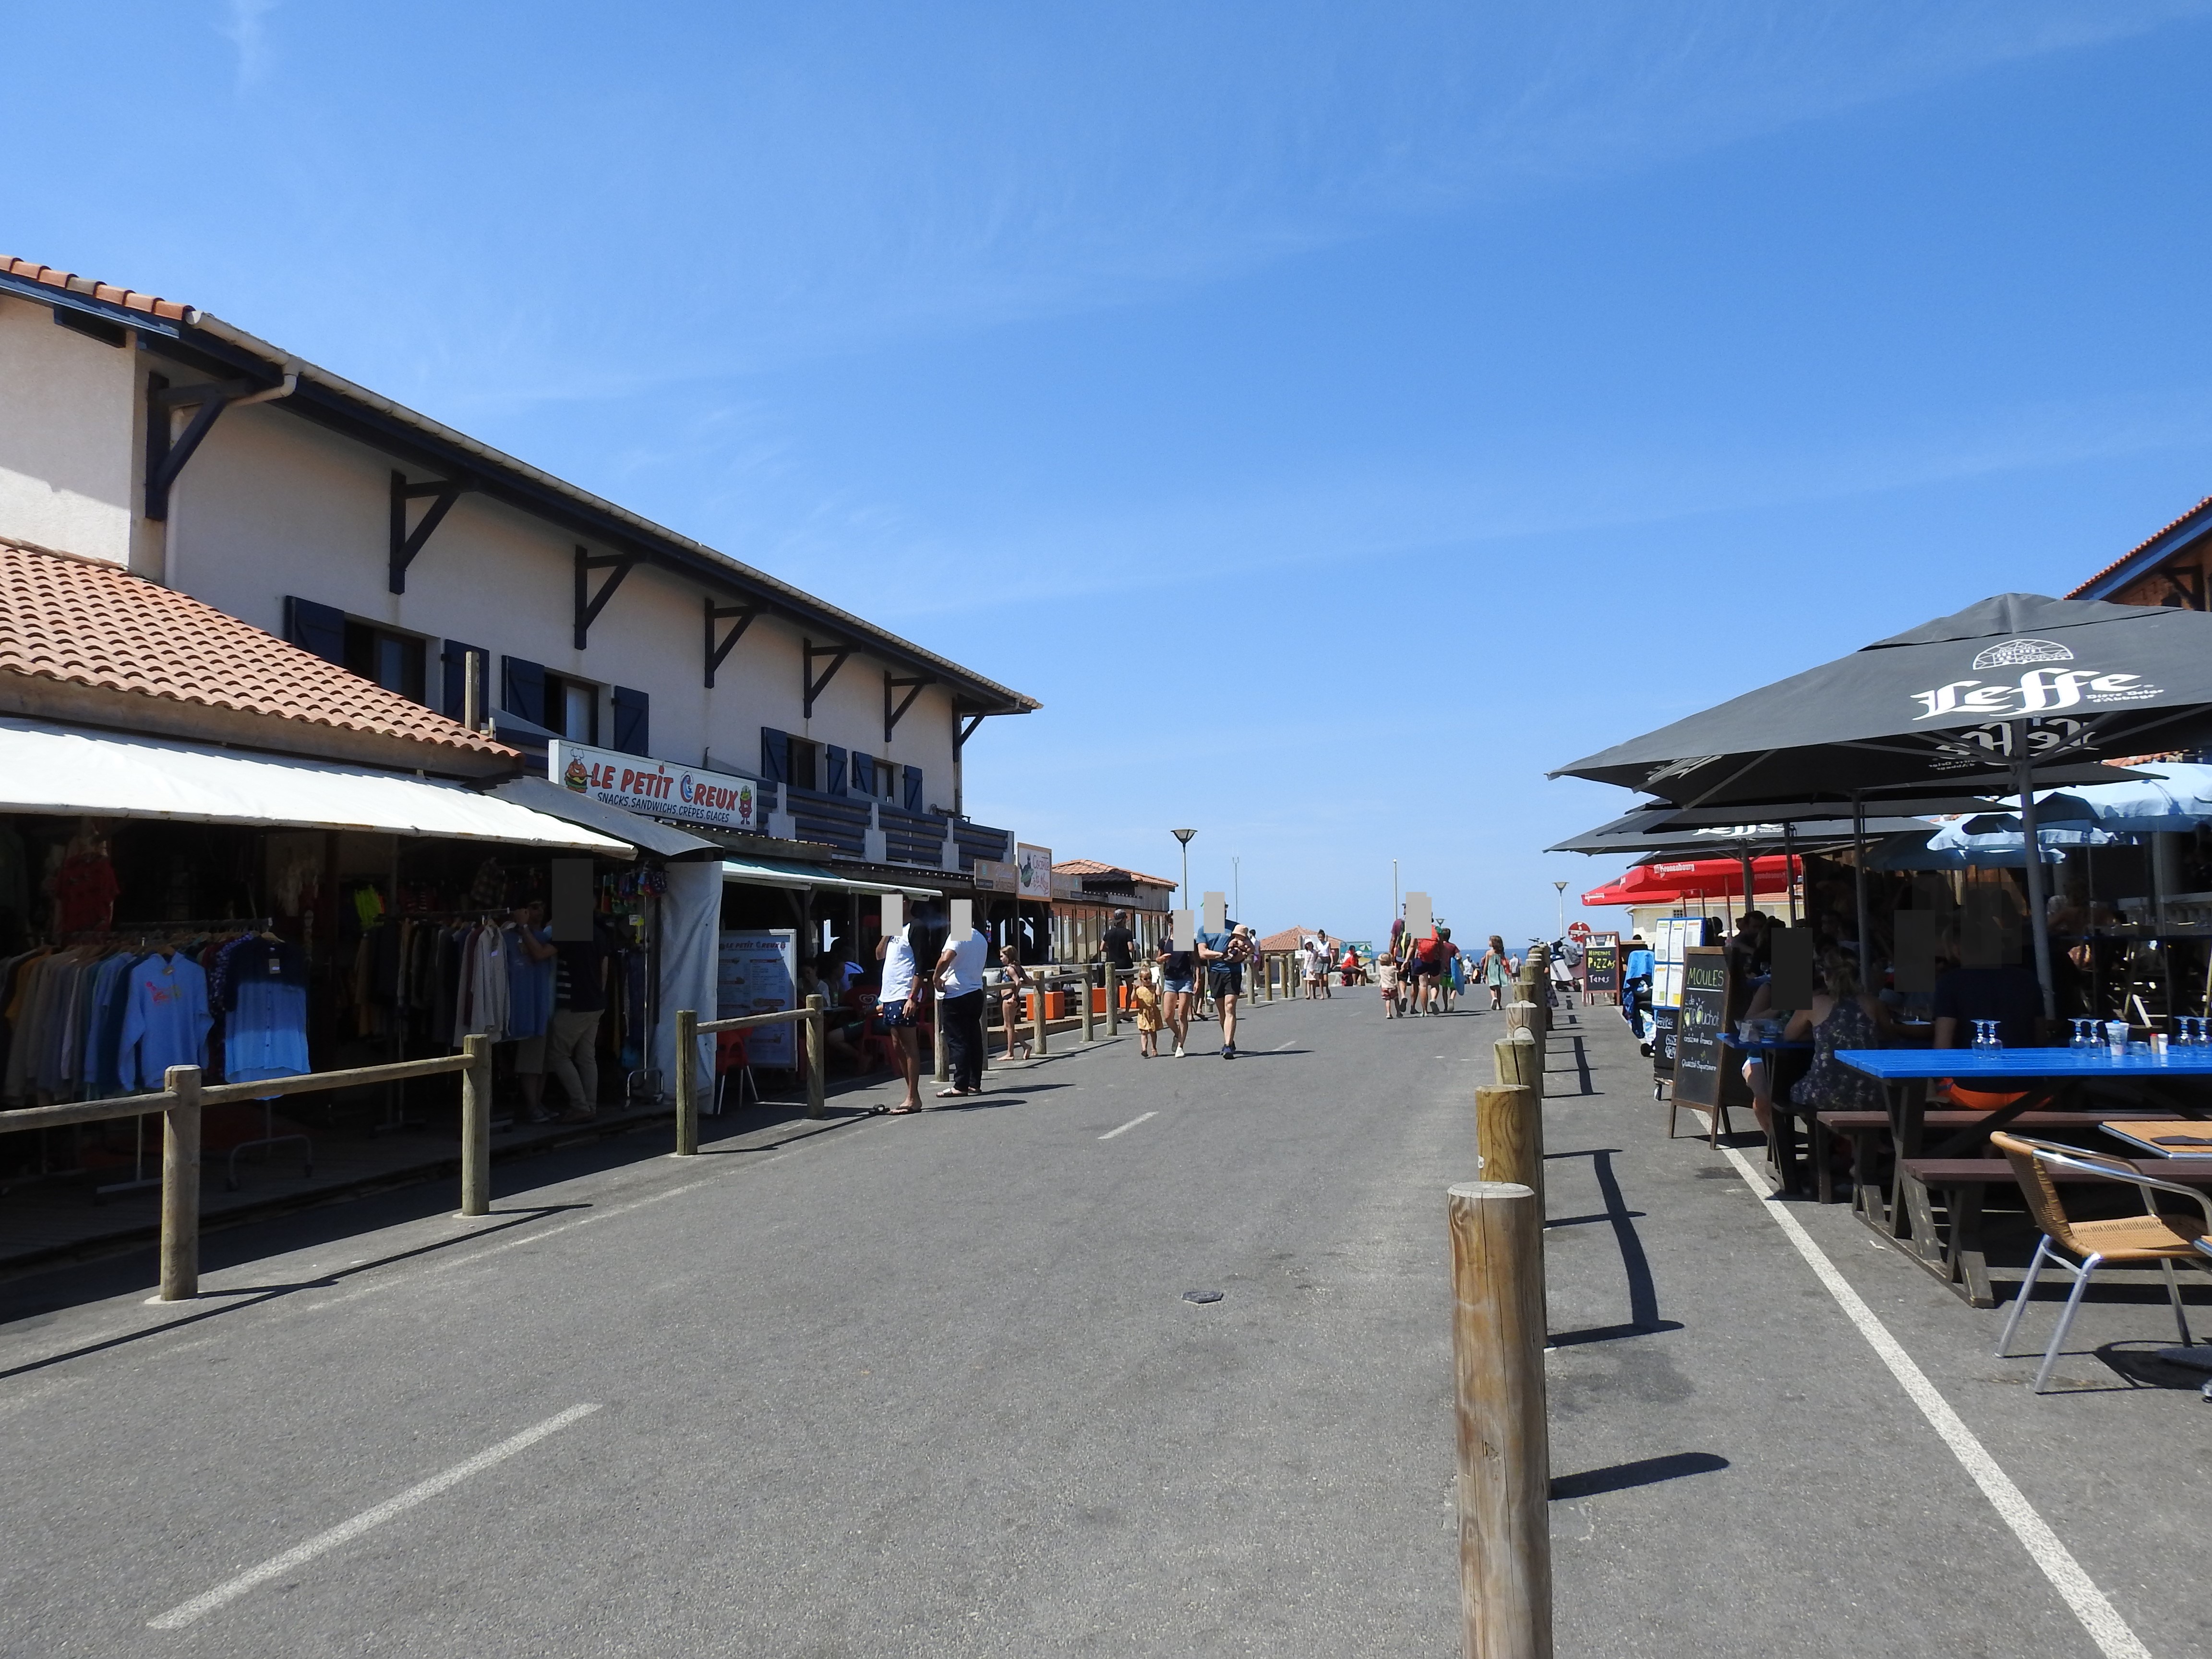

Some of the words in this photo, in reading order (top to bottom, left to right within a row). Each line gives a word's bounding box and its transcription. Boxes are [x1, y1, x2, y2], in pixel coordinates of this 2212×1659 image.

[591, 763, 616, 789] LE
[620, 765, 674, 800] PETIT
[680, 773, 738, 811] CREUX
[1687, 967, 1724, 987] MOULES
